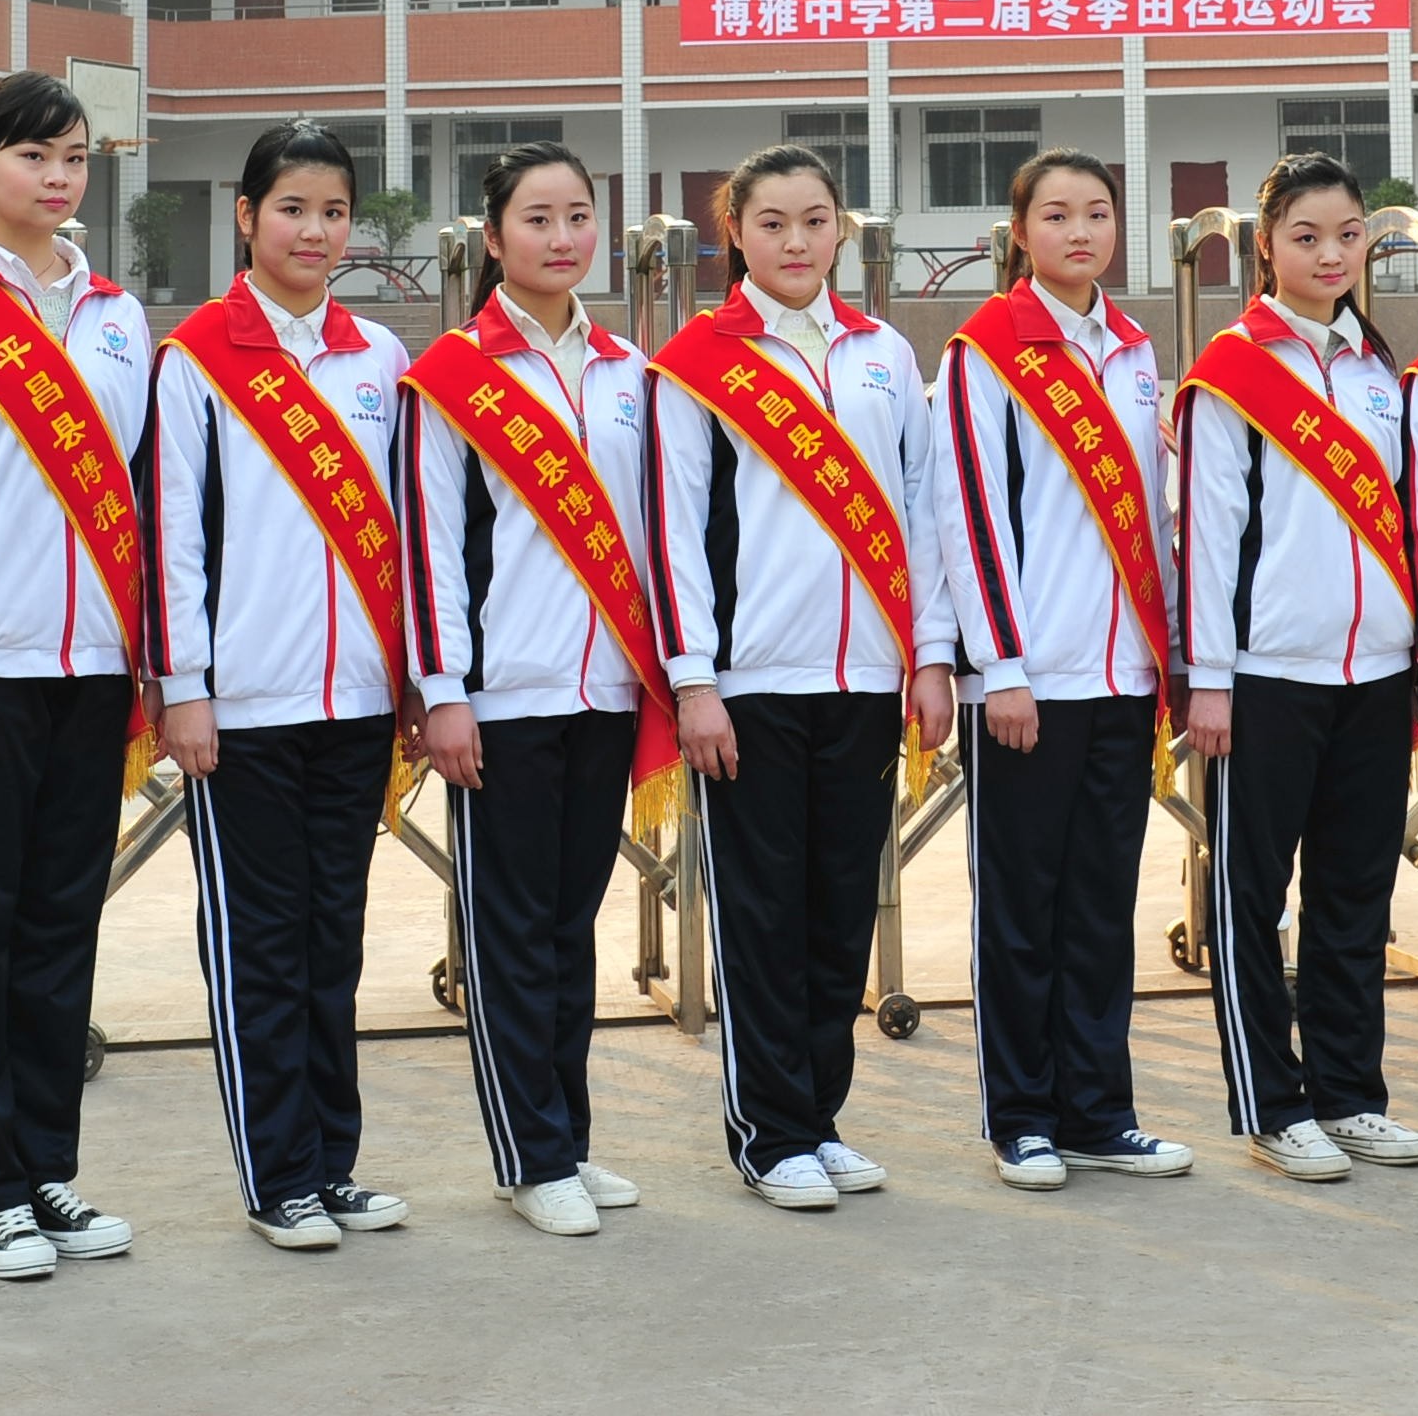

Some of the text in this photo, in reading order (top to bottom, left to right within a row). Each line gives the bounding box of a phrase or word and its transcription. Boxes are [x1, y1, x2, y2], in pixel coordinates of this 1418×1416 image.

[468, 383, 645, 629] 平昌县博雅中学
[721, 364, 909, 603] 平昌县博雅中学
[1013, 345, 1155, 604] 平昌县博雅中学
